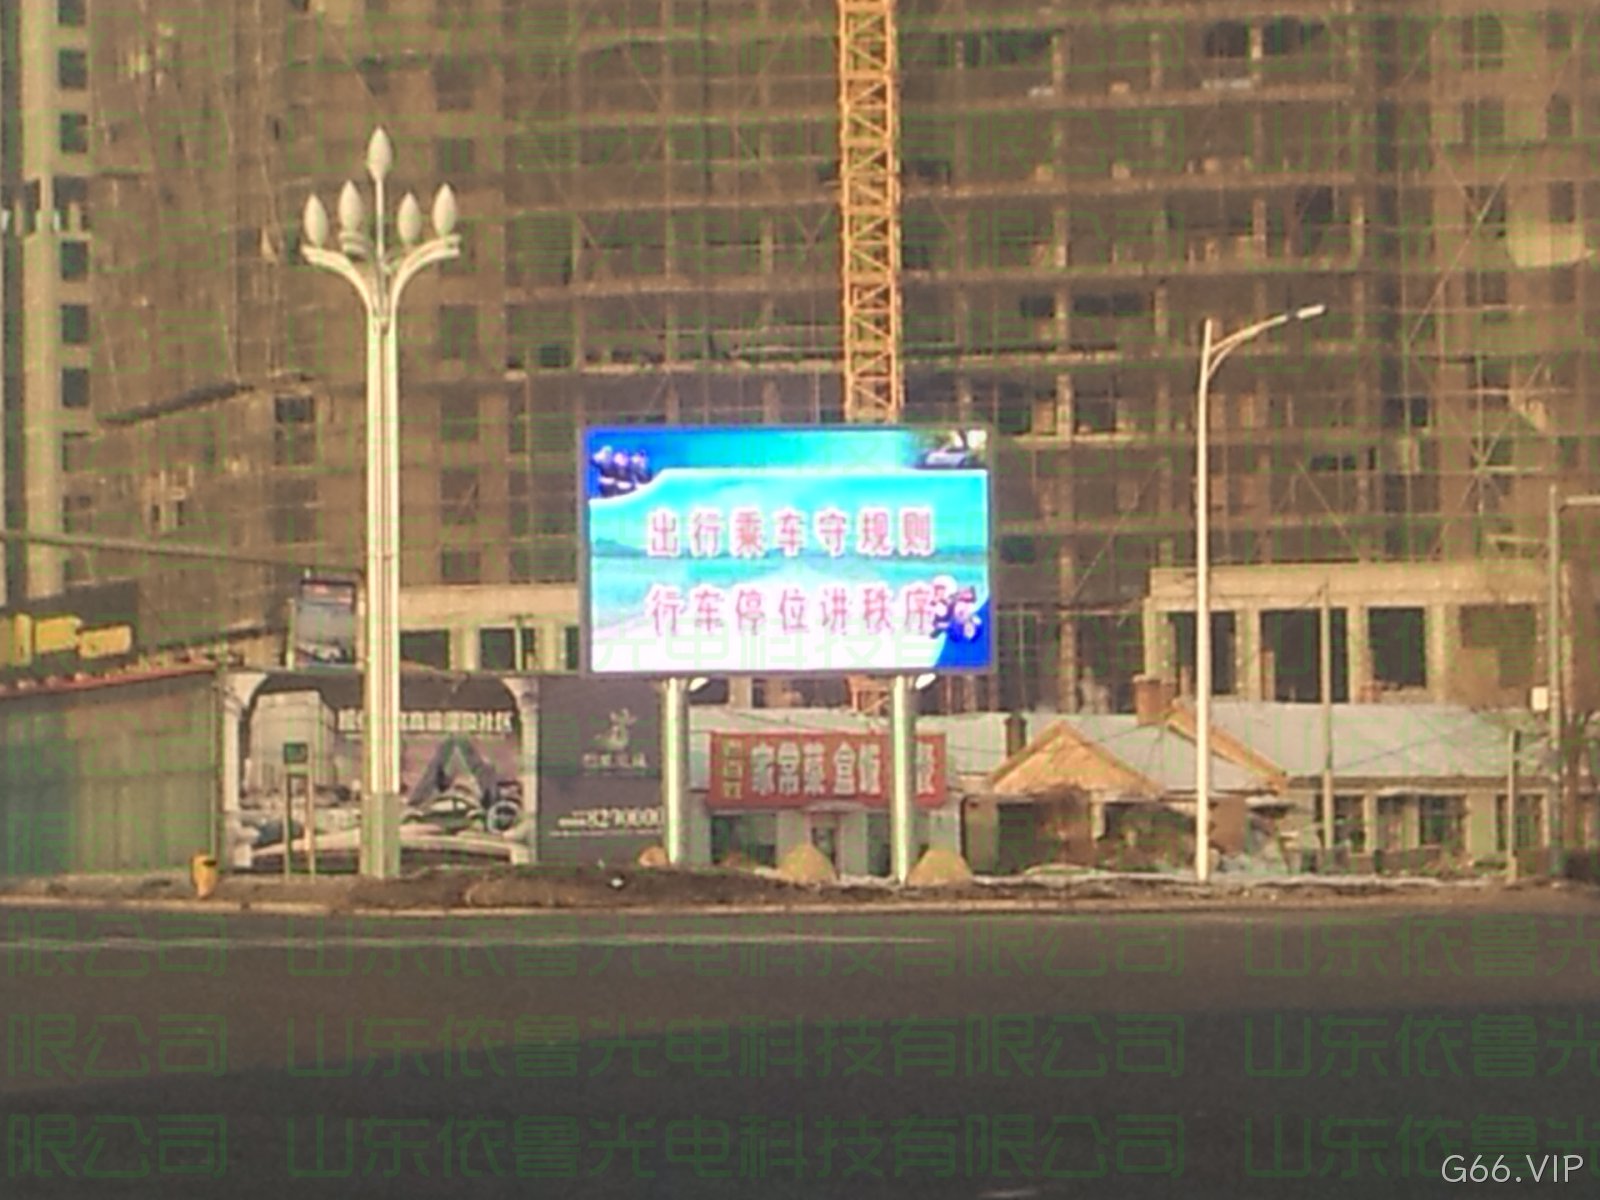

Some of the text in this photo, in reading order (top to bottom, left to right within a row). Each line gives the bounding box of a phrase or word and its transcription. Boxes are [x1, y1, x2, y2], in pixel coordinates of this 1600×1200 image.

[648, 509, 935, 556] 出行乘车守规则
